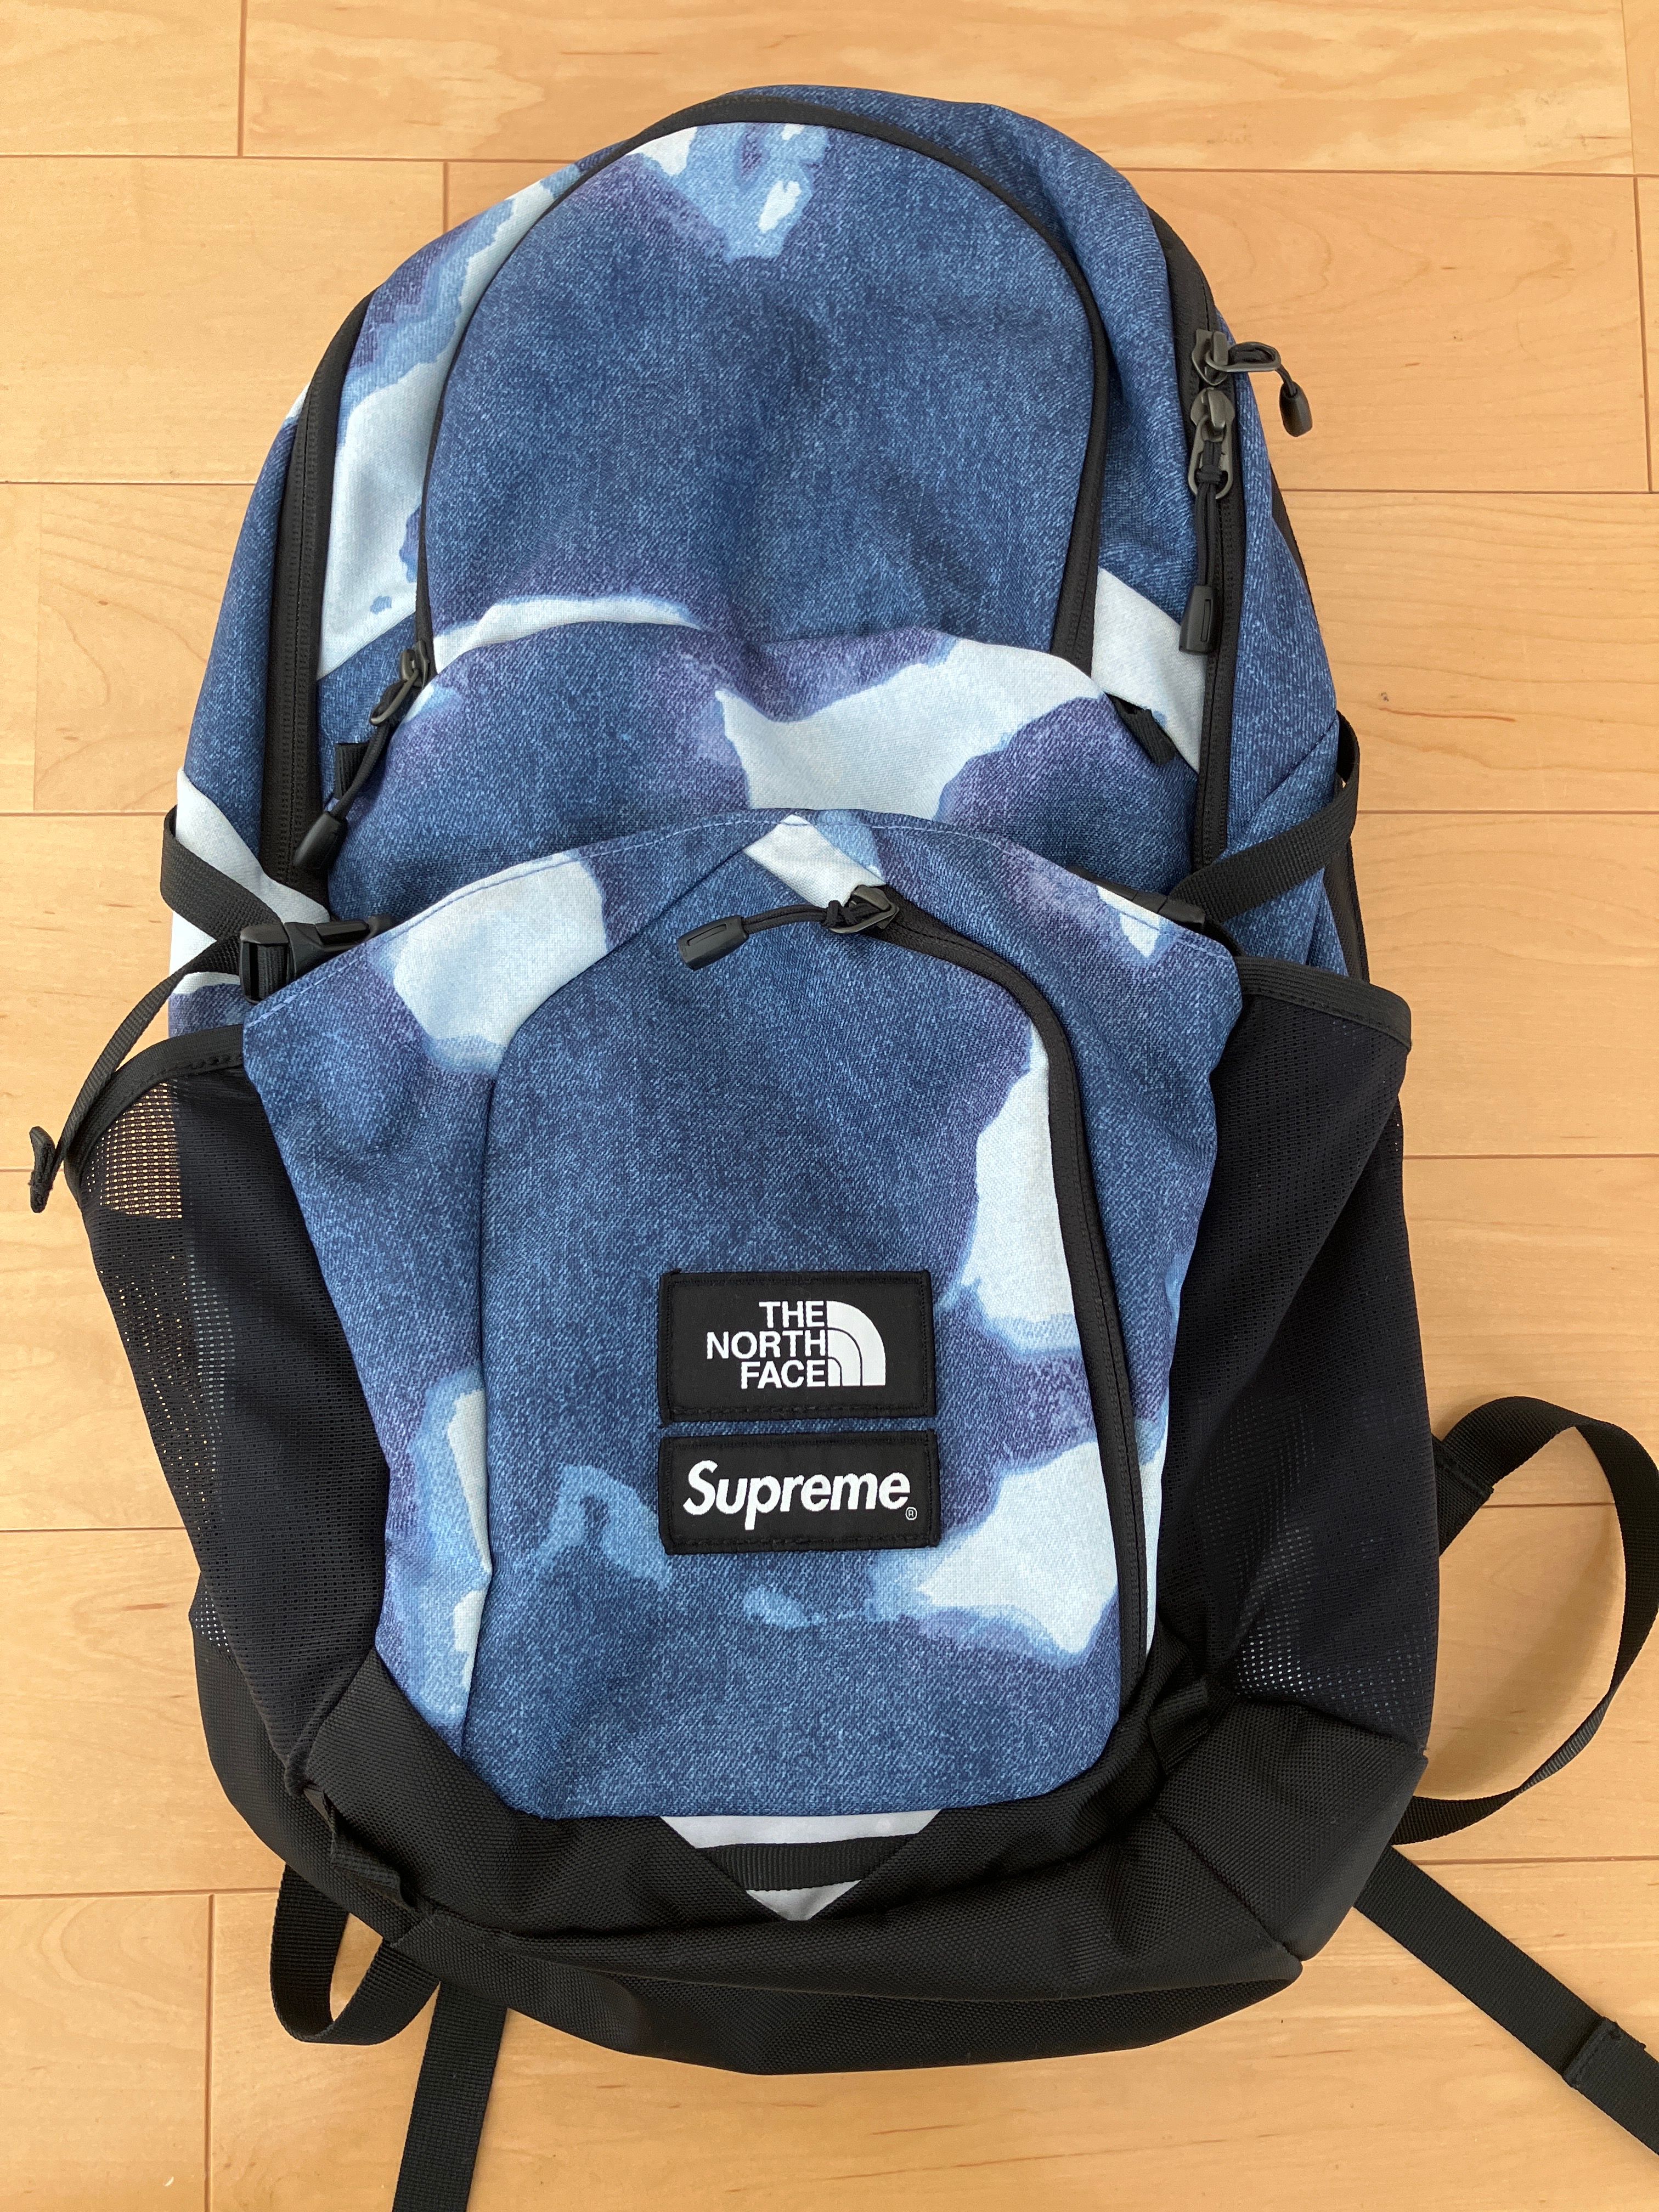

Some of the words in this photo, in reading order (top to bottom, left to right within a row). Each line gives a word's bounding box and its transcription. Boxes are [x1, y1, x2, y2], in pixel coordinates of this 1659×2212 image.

[759, 1301, 825, 1328] THE
[707, 1330, 826, 1359] NORTH
[741, 1360, 826, 1389] FACE
